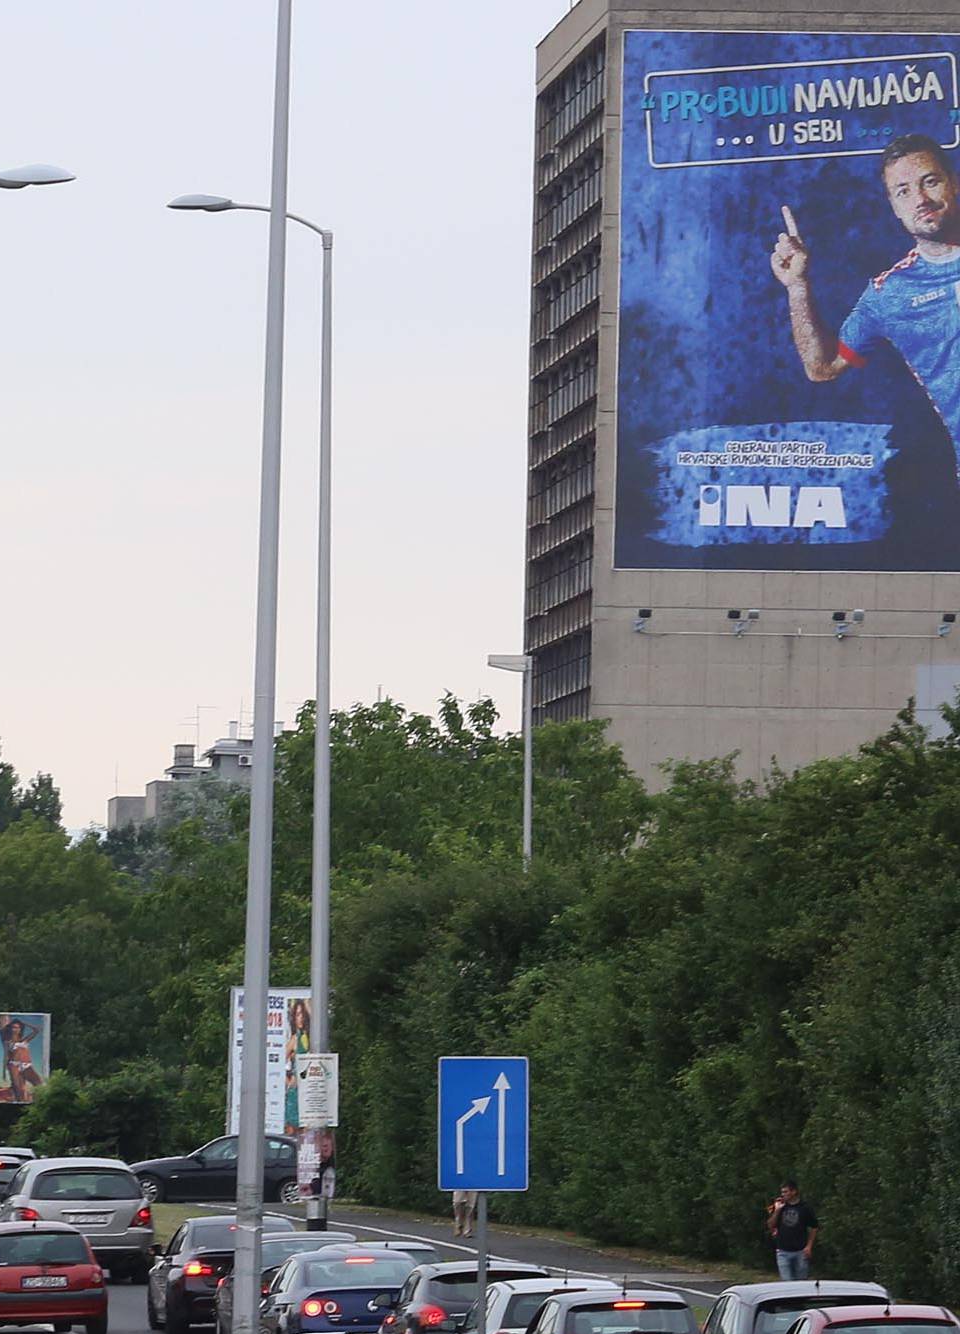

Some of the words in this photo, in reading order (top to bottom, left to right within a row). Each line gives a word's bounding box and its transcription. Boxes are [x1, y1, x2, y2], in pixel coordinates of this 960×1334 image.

[793, 64, 945, 114] NAVIJAČA
[768, 122, 786, 145] U
[793, 119, 845, 145] SEBI
[725, 441, 777, 454] GENERALNI
[780, 441, 826, 455] PARTNER
[677, 453, 728, 466] HRVATSKE
[731, 454, 790, 466] RUKOMETNE
[266, 1012, 283, 1028] 018
